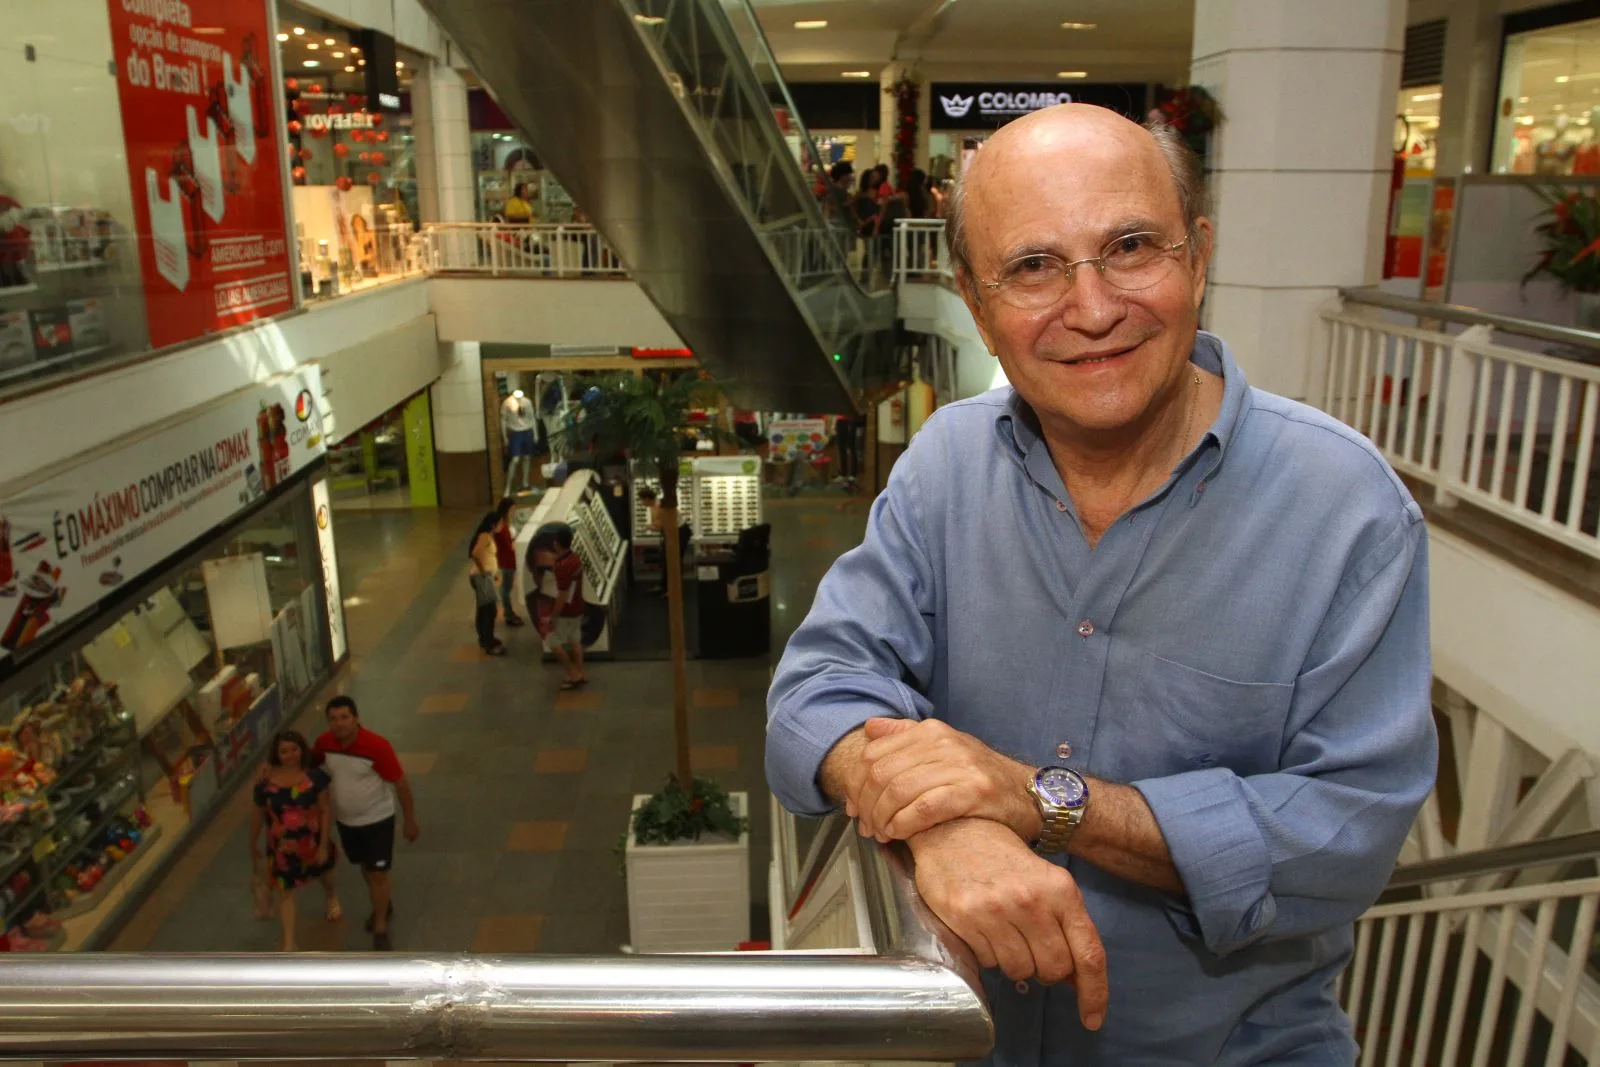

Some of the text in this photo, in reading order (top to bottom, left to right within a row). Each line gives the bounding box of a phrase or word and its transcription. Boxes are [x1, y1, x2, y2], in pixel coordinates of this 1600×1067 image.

[129, 23, 164, 53] opção
[165, 29, 180, 53] de
[127, 47, 151, 88] do
[978, 92, 1072, 109] COLOMBO
[214, 278, 288, 310] LOJAS AMERICANAS
[54, 510, 68, 560] É
[66, 513, 80, 551] O
[79, 491, 140, 547] MÁXIMO
[139, 453, 201, 513] COMPRAR
[199, 445, 217, 481] NA
[214, 427, 251, 473] COMAX
